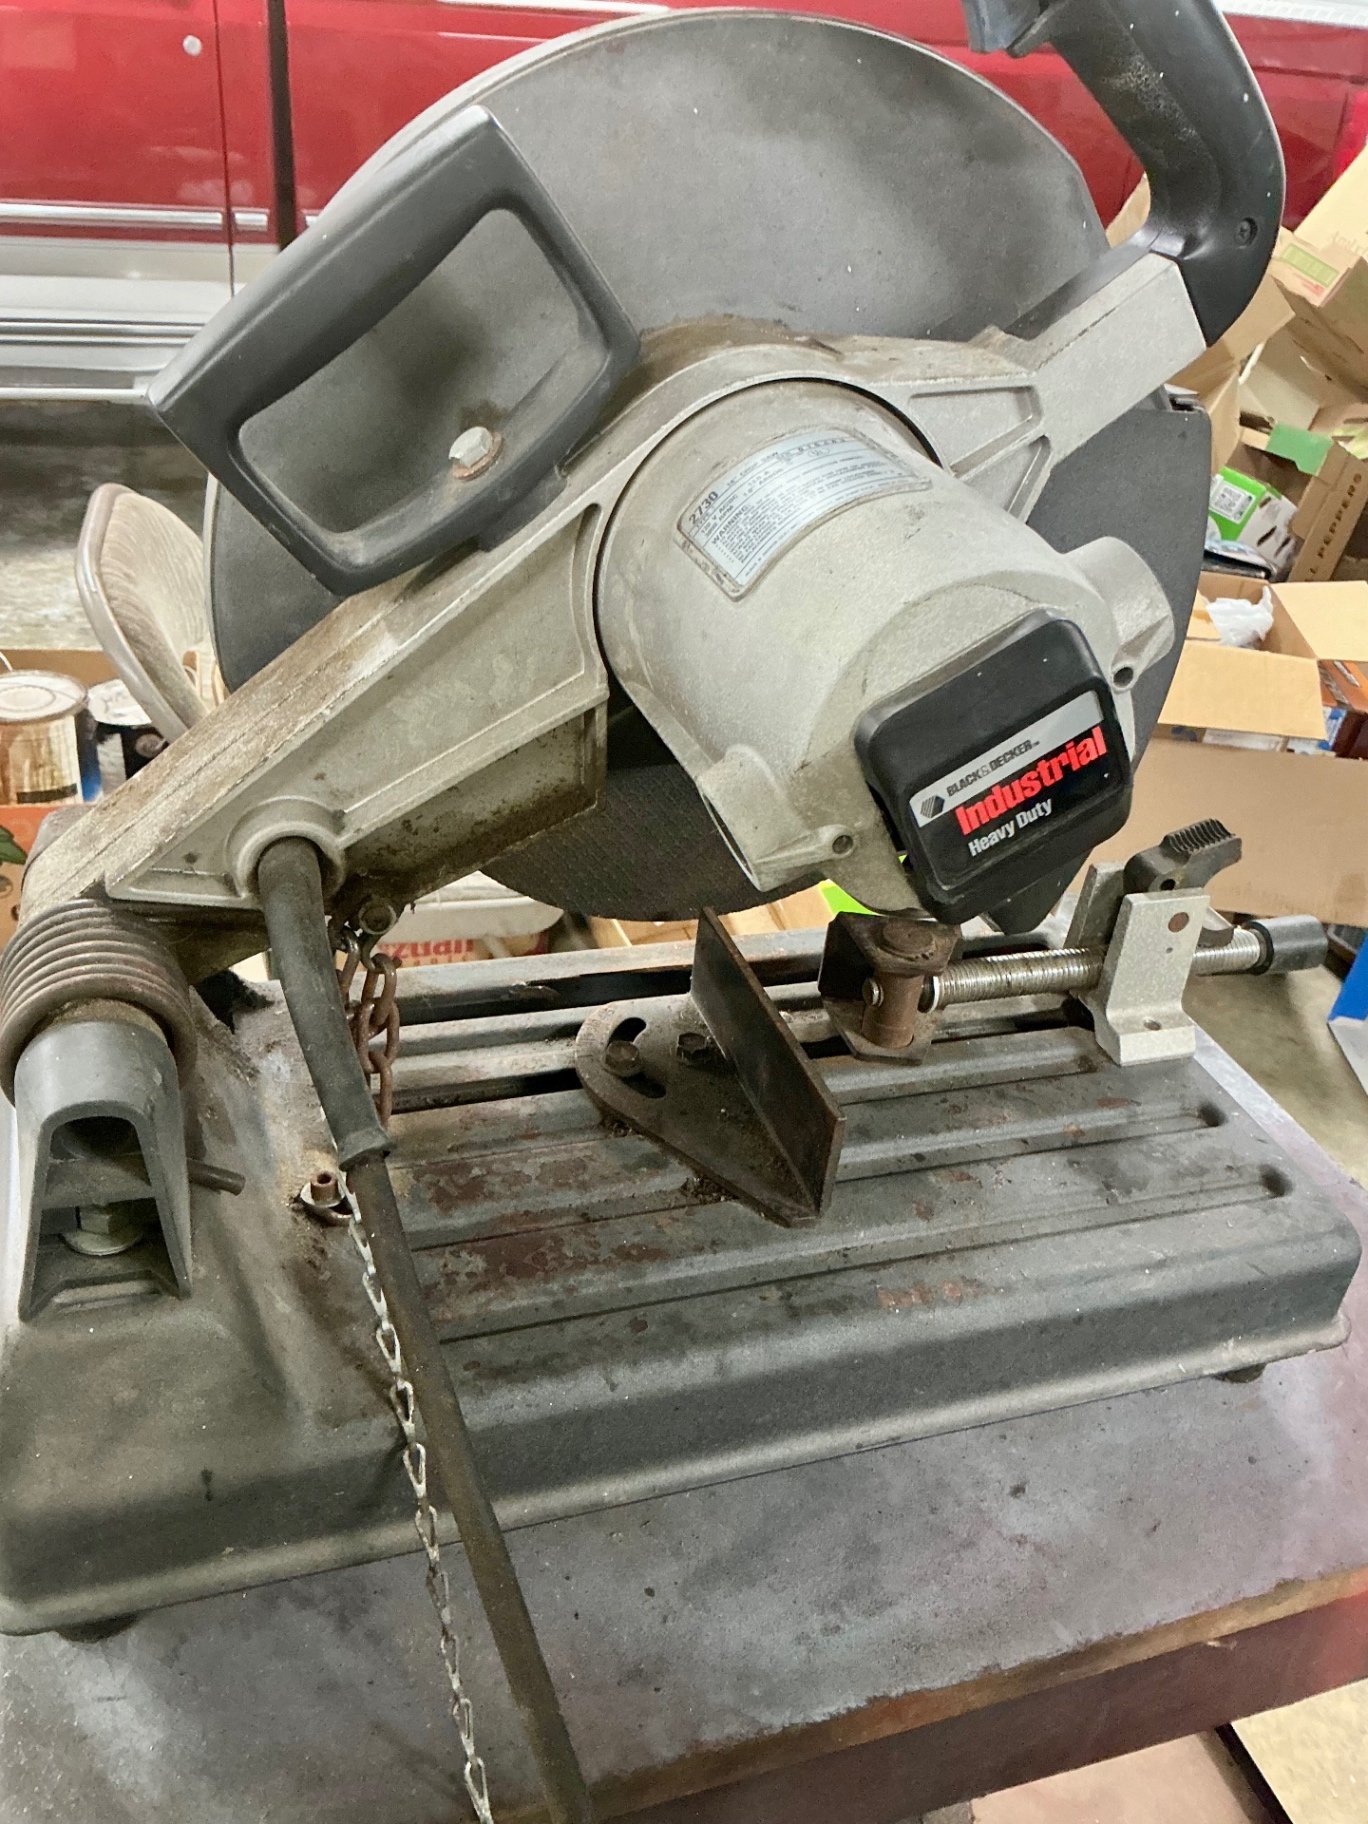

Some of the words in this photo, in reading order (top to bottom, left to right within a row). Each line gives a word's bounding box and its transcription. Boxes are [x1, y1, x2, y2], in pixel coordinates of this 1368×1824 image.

[689, 491, 719, 525] 2730
[955, 725, 1107, 836] Industrial
[967, 819, 1016, 858] Heavy
[1015, 798, 1052, 829] Duty
